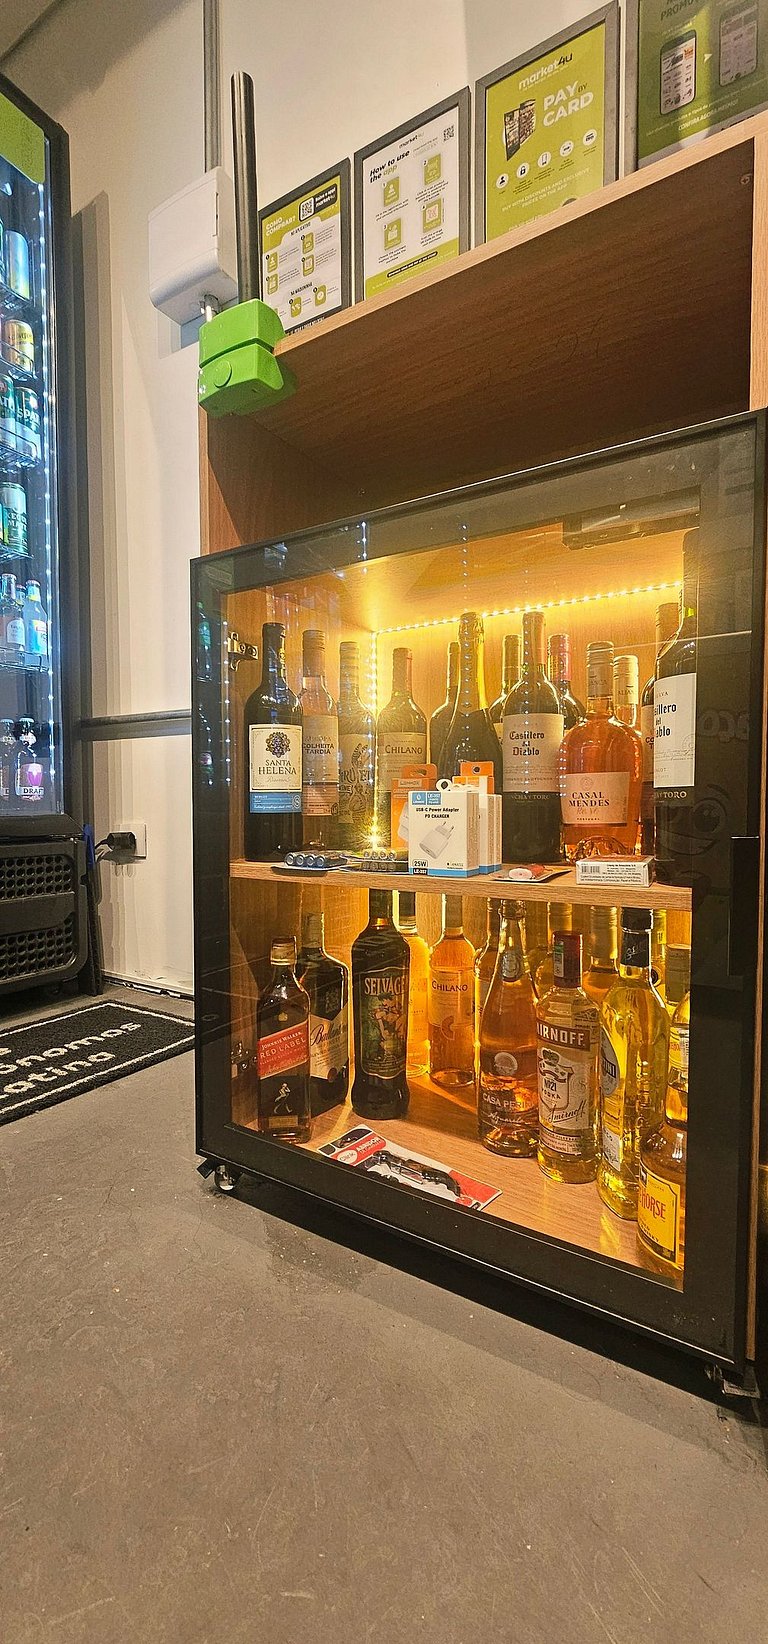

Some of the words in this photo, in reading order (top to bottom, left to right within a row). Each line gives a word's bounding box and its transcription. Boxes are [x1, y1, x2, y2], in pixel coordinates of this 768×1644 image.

[519, 53, 573, 90] market4u
[543, 80, 579, 111] PAY
[543, 92, 594, 126] CARD
[369, 163, 386, 177] How
[387, 159, 395, 167] to
[396, 150, 410, 161] use
[369, 173, 382, 184] the
[384, 744, 423, 755] CHILANO
[512, 747, 540, 756] Diablo
[265, 759, 292, 767] SANTA
[258, 766, 297, 775] HELENA
[572, 791, 605, 800] CASAL
[568, 799, 610, 807] MENDES
[364, 976, 405, 996] SELVAG
[431, 980, 468, 992] CHILANO
[259, 1048, 277, 1060] RED
[279, 1036, 307, 1052] LABEL
[482, 1092, 502, 1108] CASA
[548, 1099, 588, 1123] Smirnoff
